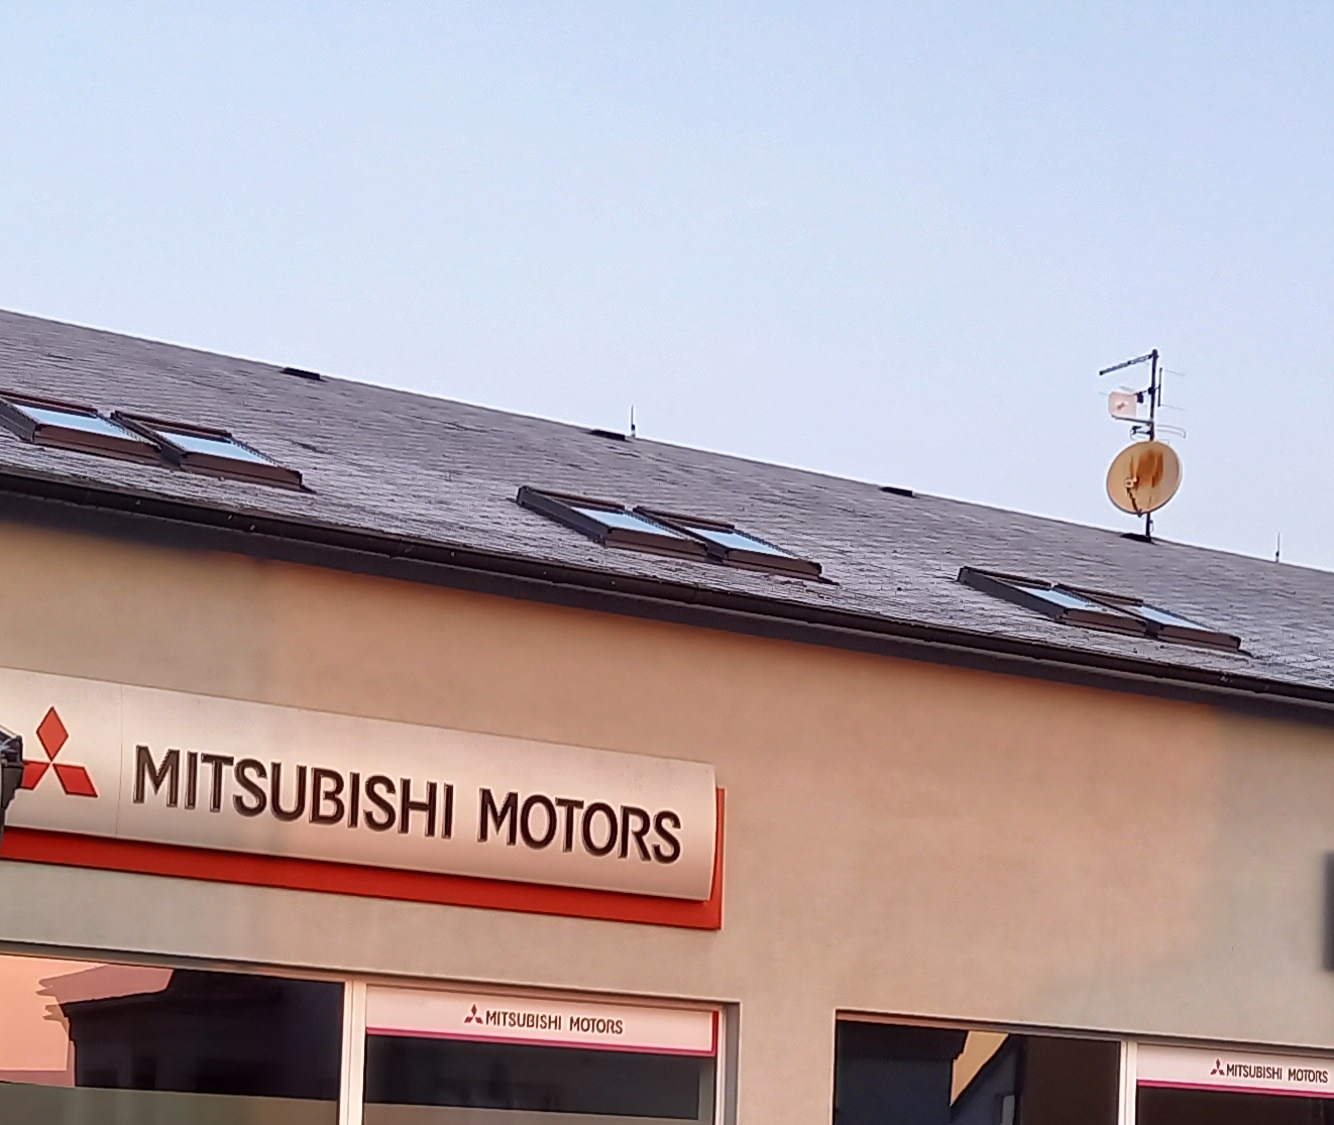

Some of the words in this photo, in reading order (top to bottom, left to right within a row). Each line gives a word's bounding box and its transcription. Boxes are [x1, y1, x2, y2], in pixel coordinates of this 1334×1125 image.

[132, 744, 455, 841] MITSUBISHI
[475, 786, 683, 865] MOTORS
[485, 1010, 562, 1031] MITSUBISHI
[569, 1016, 624, 1035] MOTORS
[1226, 1063, 1283, 1081] MITSUBISHI
[1287, 1068, 1329, 1084] MOTORS
